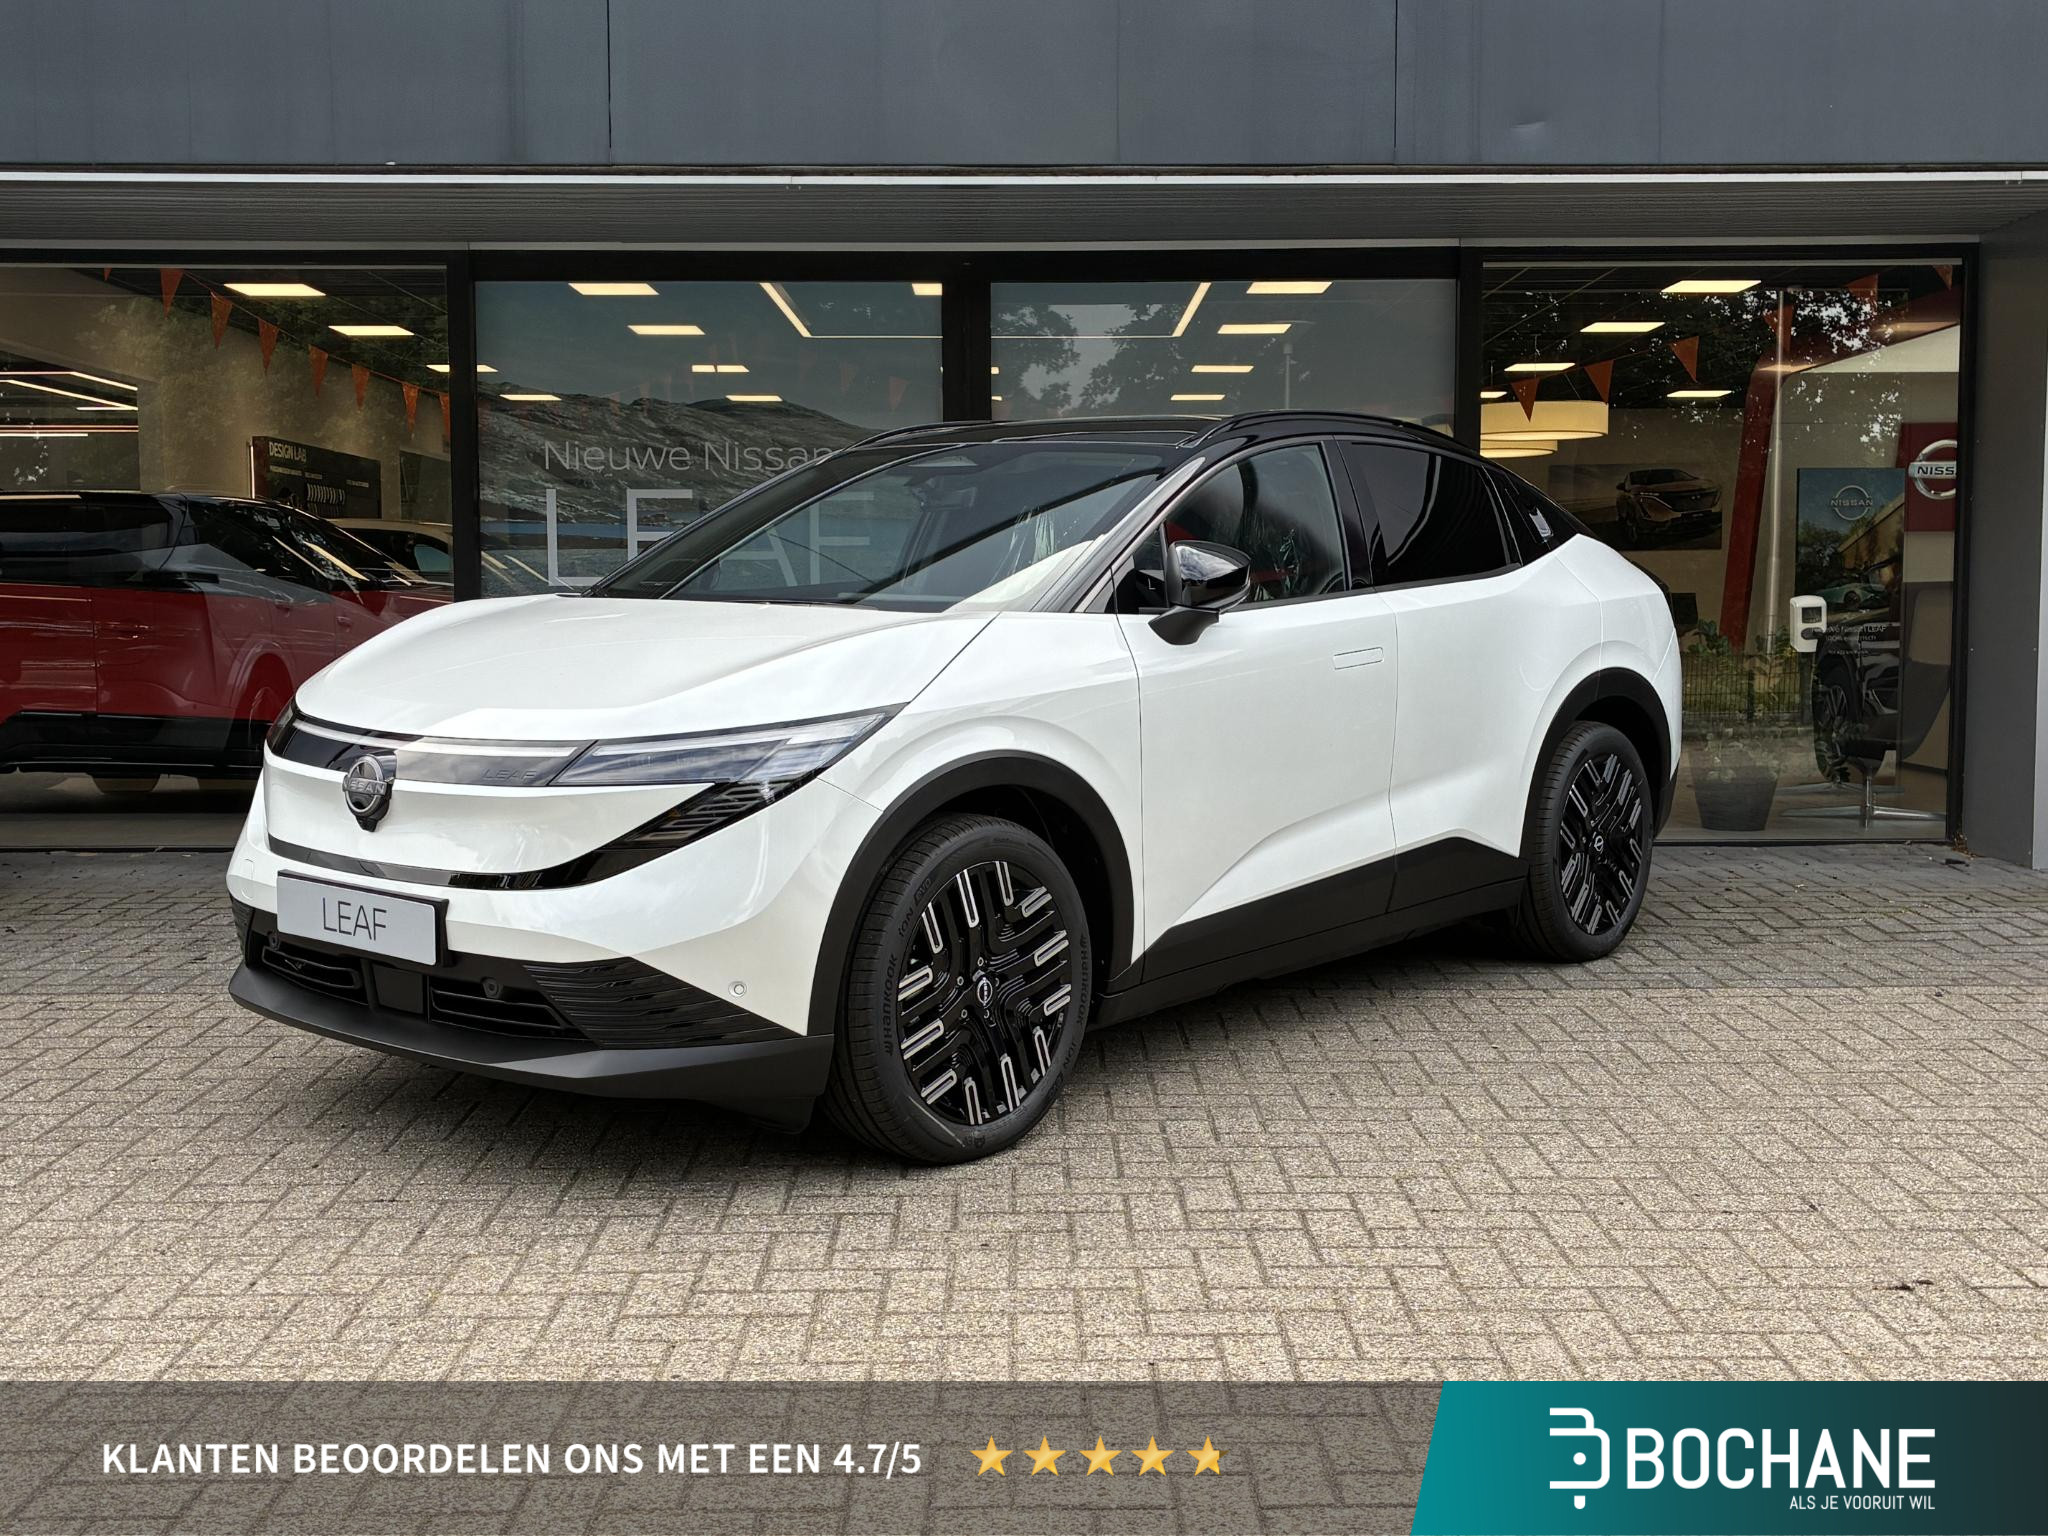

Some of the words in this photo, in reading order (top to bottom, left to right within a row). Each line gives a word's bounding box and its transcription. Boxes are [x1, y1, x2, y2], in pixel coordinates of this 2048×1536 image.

[268, 441, 294, 460] DESIGN
[544, 440, 690, 471] Nieuwe
[1917, 466, 1956, 475] NISS
[1831, 499, 1873, 507] NISSAN
[482, 768, 537, 780] LEAF
[322, 897, 387, 941] LEAF
